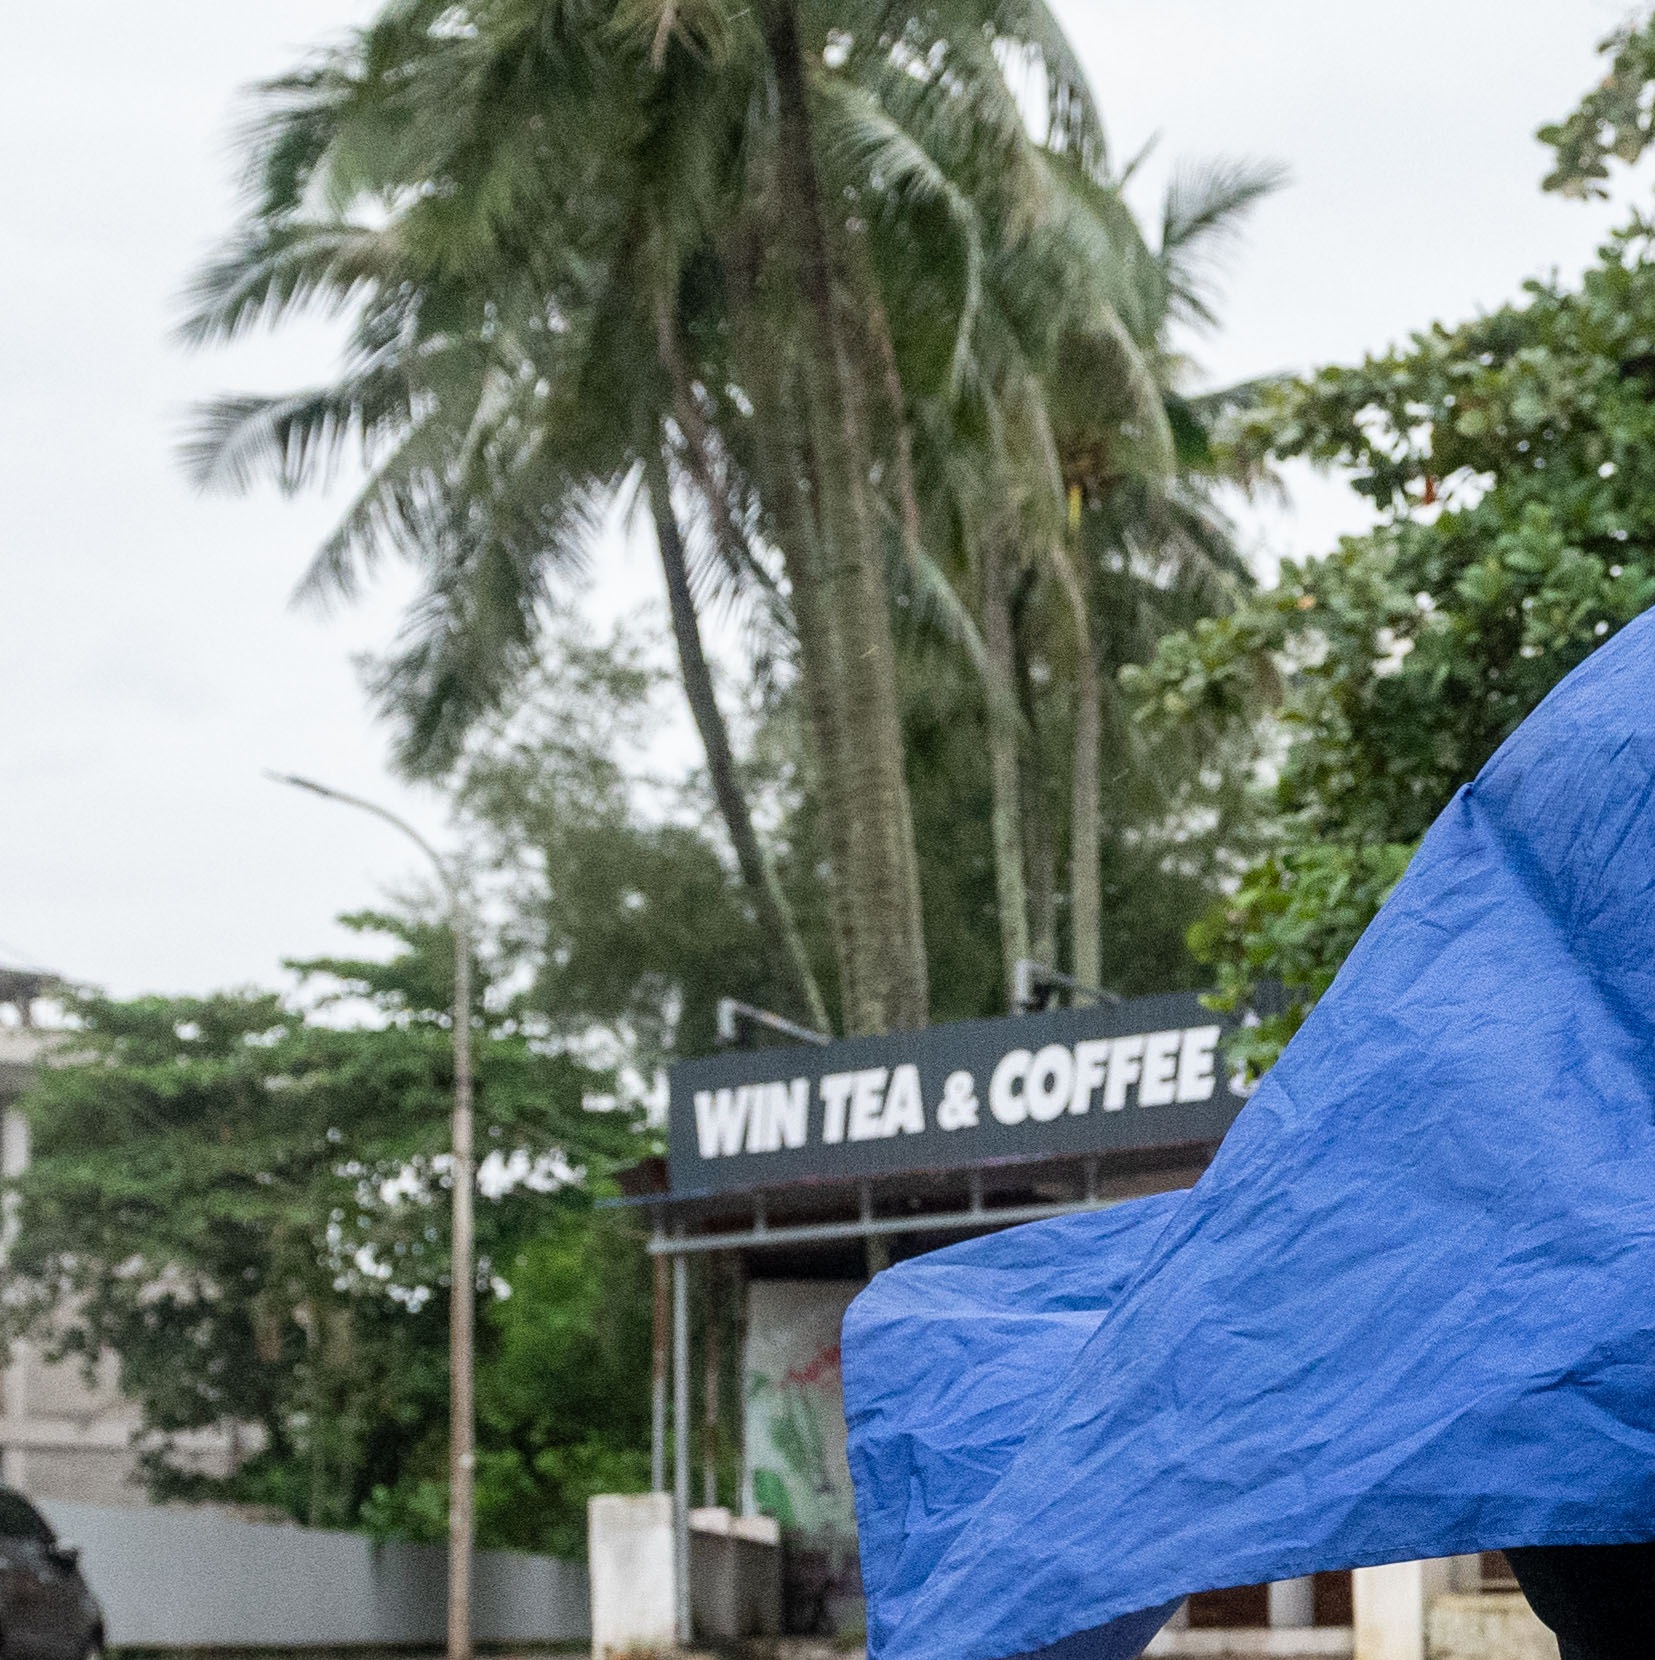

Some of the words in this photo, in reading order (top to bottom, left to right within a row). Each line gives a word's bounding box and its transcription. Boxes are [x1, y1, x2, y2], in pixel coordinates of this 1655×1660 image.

[695, 1079, 808, 1158] WIN
[820, 1064, 925, 1143] TEA
[937, 1070, 980, 1131] &
[989, 1025, 1222, 1125] COFFEE
